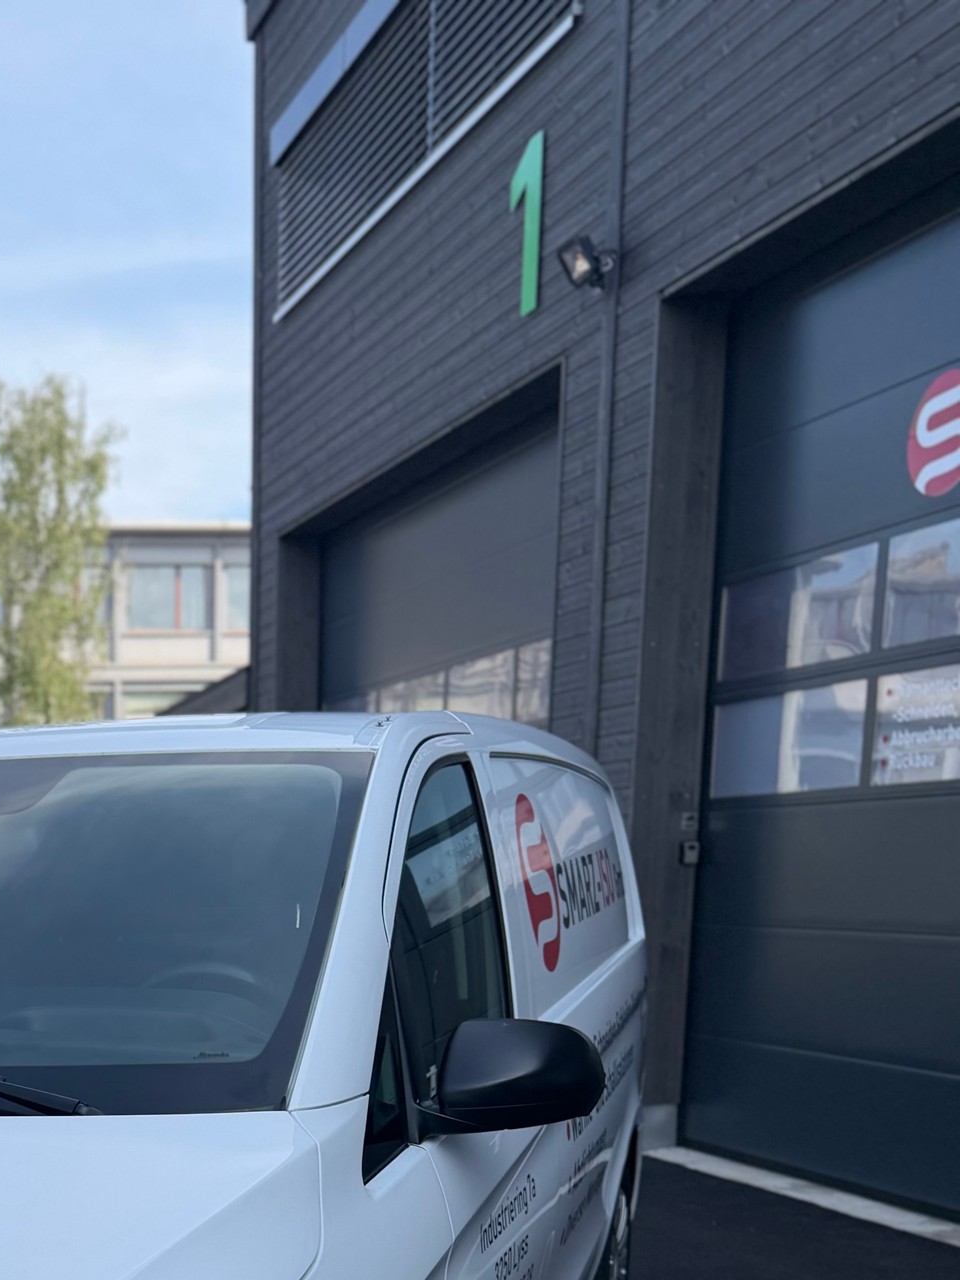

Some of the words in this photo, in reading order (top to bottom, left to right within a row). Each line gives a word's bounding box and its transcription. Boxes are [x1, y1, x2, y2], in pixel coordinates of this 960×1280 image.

[509, 130, 544, 318] 1
[479, 1186, 529, 1254] Industriering
[513, 1234, 529, 1272] Lyss
